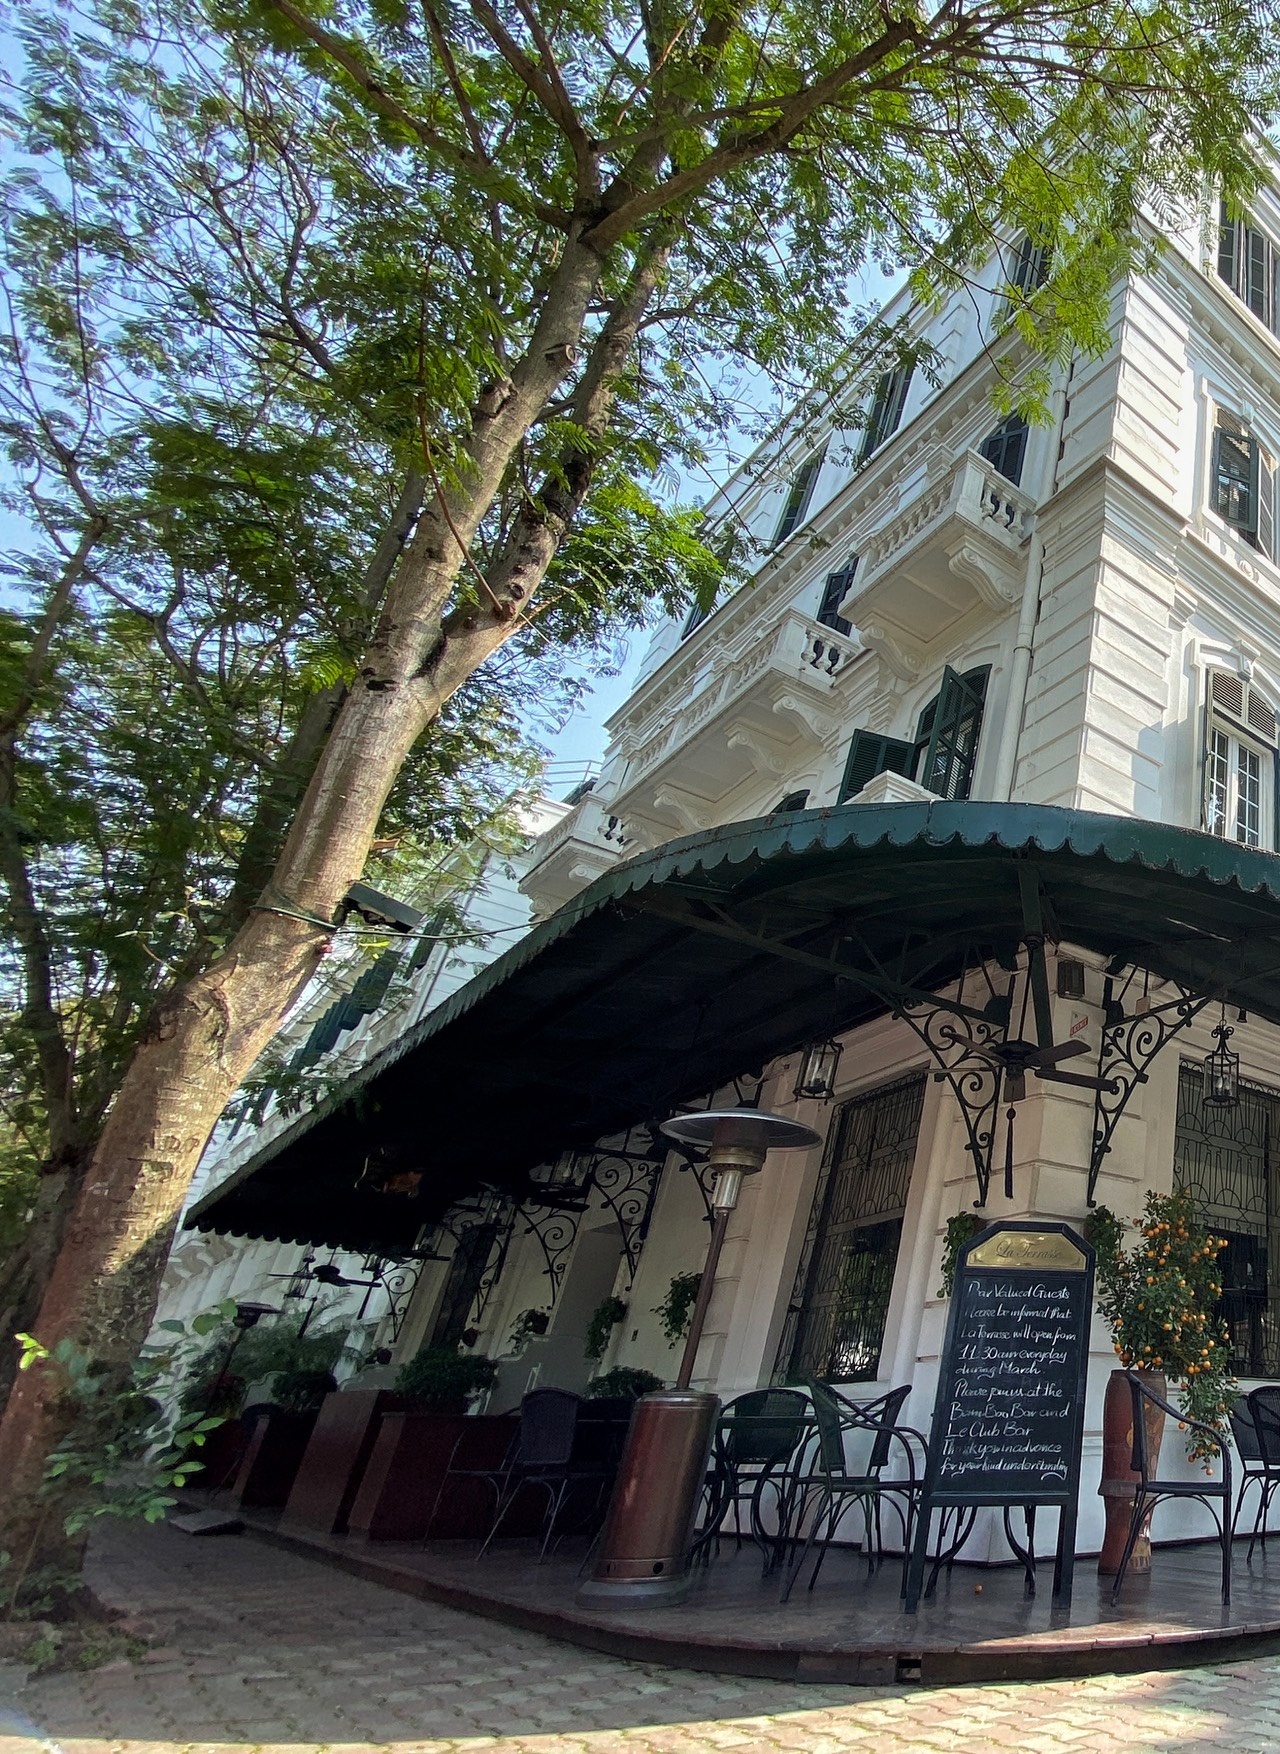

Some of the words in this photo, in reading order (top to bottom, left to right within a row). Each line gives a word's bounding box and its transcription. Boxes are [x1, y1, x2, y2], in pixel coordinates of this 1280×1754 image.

[995, 1240, 1013, 1258] La
[1016, 1239, 1060, 1259] Terrasse
[994, 1283, 1033, 1298] Valued
[1032, 1283, 1071, 1300] Guests
[1050, 1306, 1072, 1319] that
[961, 1323, 976, 1338] La
[1013, 1323, 1031, 1339] will
[1031, 1330, 1053, 1343] open
[955, 1363, 997, 1380] during
[1026, 1382, 1042, 1397] at
[1042, 1382, 1063, 1398] the
[1010, 1402, 1037, 1418] Bar
[1039, 1402, 1070, 1418] and
[945, 1422, 968, 1438] Le
[969, 1421, 1001, 1437] Club
[1003, 1421, 1034, 1437] Bar
[942, 1439, 978, 1455] Thnk
[1012, 1439, 1062, 1453] advance
[940, 1457, 959, 1476] for
